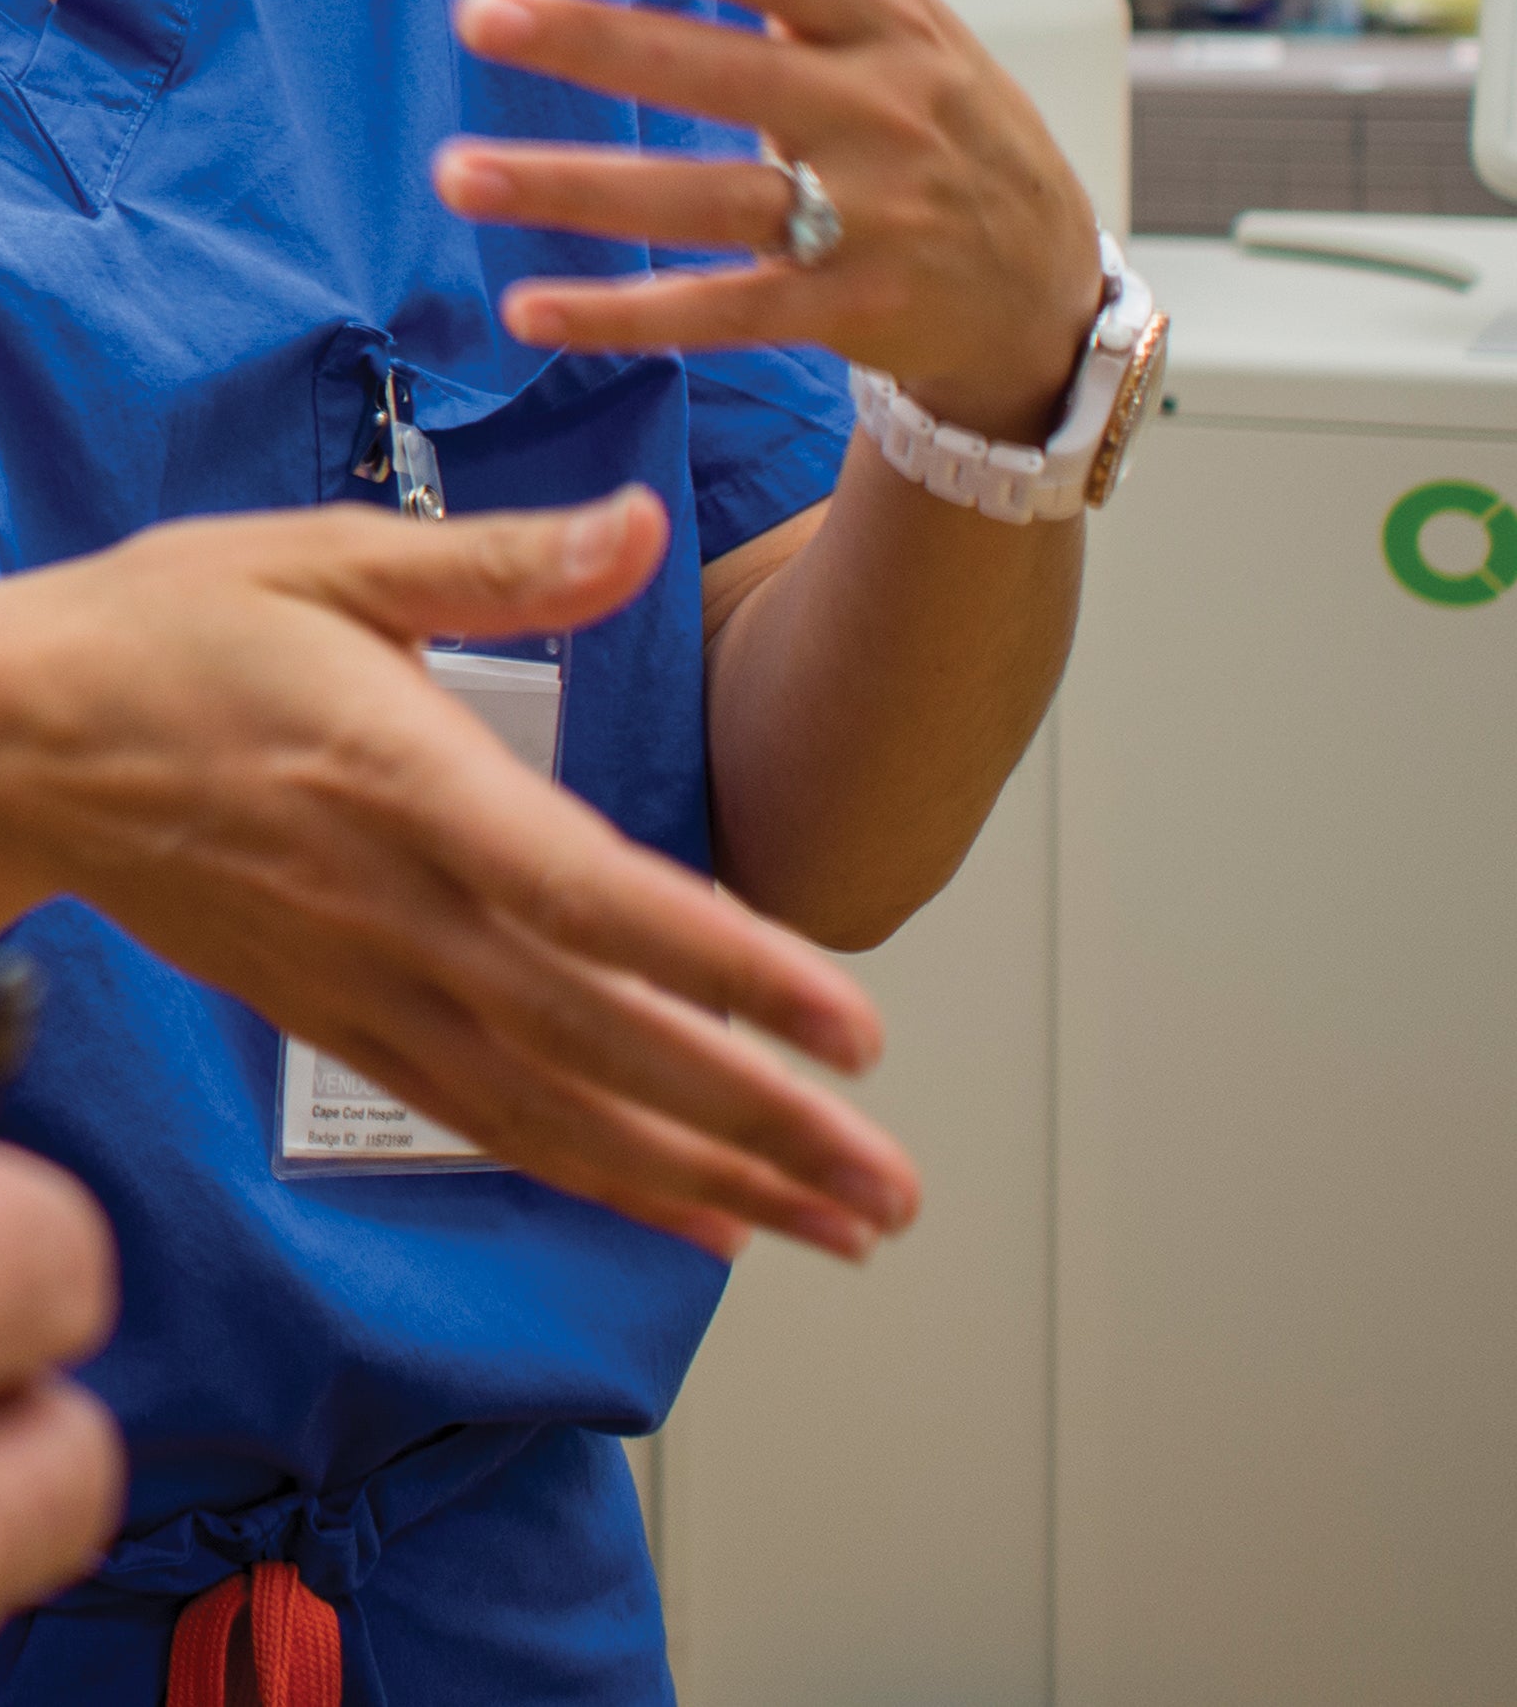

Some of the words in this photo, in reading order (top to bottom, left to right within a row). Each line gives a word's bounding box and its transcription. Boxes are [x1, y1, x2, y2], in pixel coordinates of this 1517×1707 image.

[312, 1105, 340, 1121] Cape
[343, 1107, 365, 1120] Cod
[367, 1107, 406, 1123] Hospital
[308, 1131, 340, 1147] Badge
